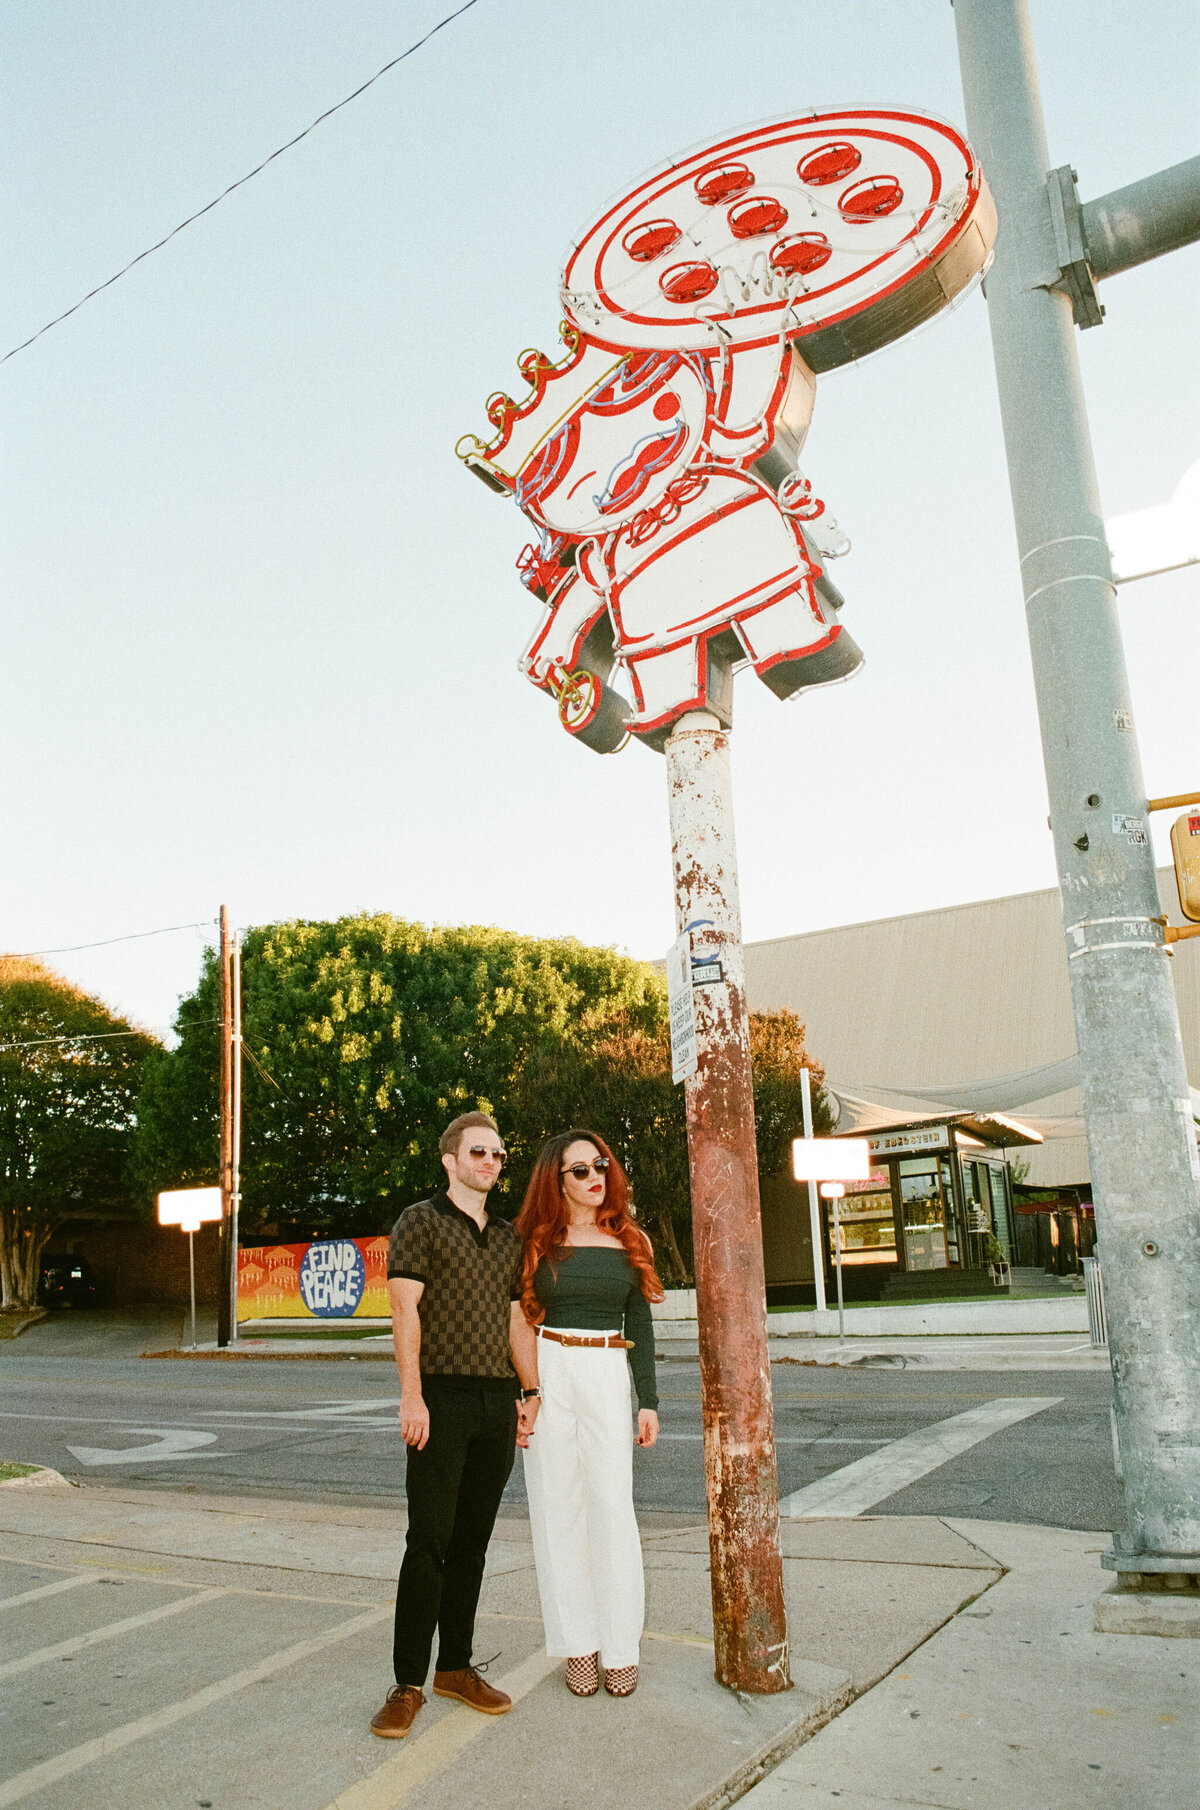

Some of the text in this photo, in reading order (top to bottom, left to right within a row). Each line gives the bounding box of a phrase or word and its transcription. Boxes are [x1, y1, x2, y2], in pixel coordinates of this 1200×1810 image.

[677, 1047, 690, 1064] CLEAN
[307, 1243, 356, 1272] FIND
[301, 1269, 360, 1310] PEACE
